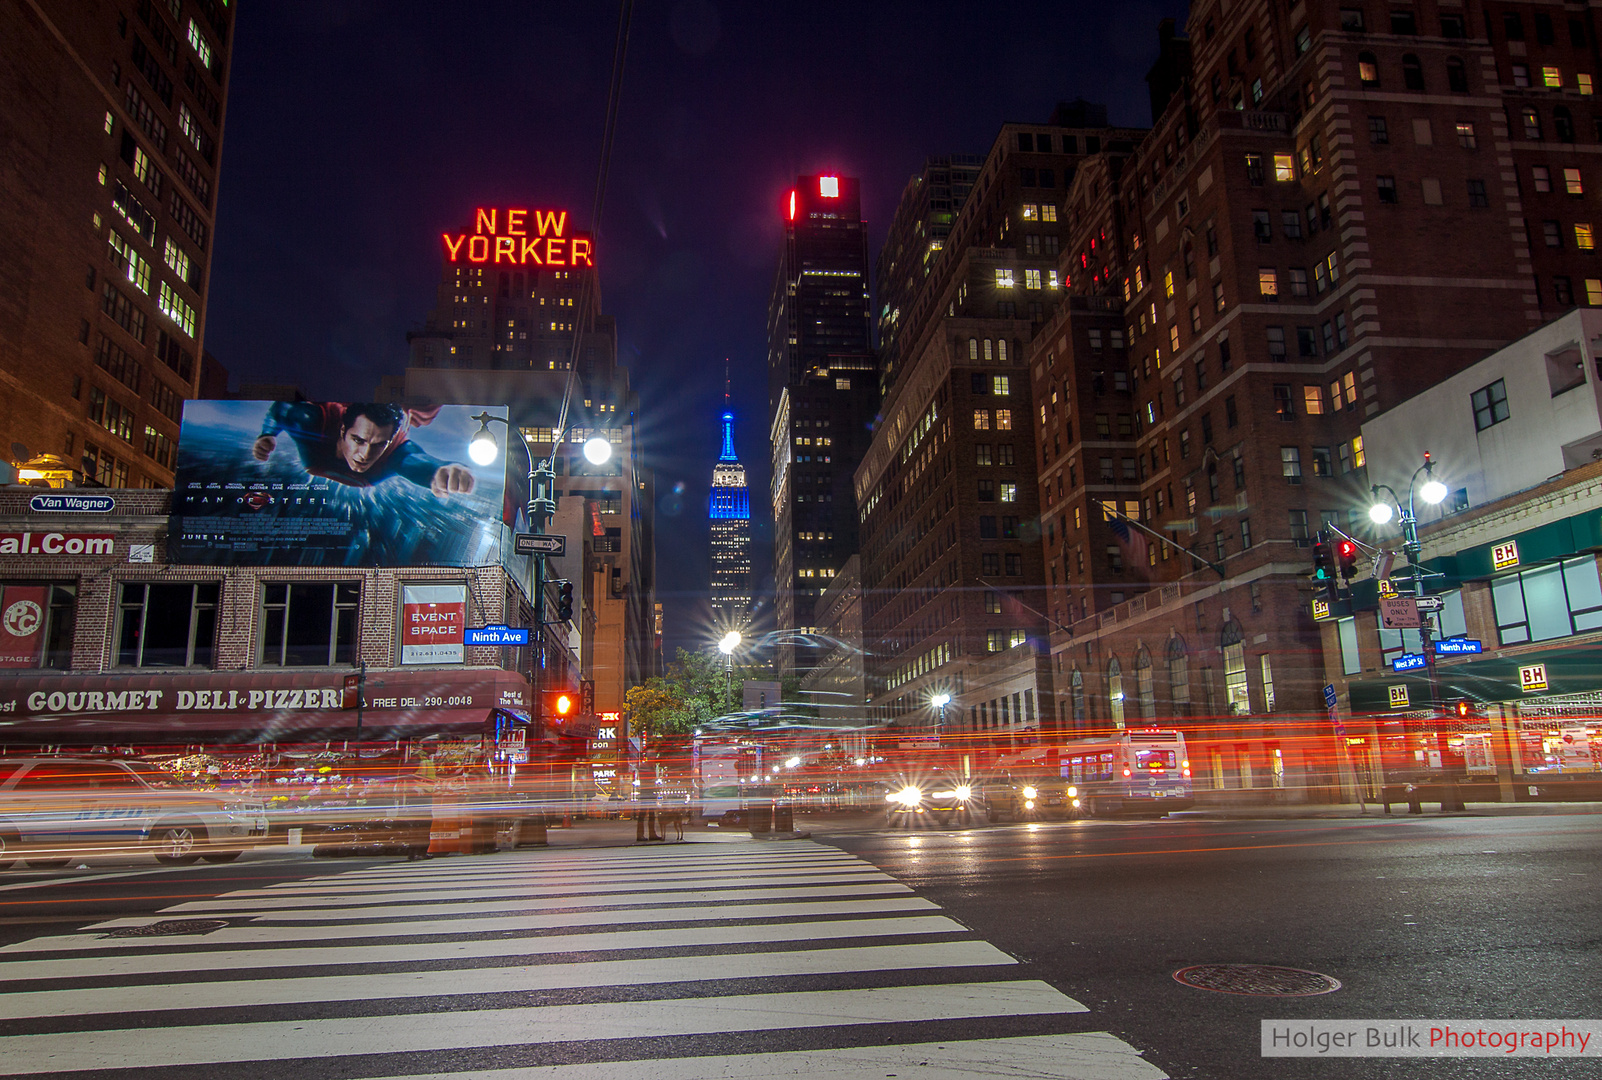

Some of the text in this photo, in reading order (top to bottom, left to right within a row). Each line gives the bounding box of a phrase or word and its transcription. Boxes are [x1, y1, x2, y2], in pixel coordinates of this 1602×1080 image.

[477, 208, 566, 237] NEW
[443, 232, 592, 266] YORKER
[40, 497, 109, 510] Van Wagner
[269, 497, 328, 505] STEEL
[0, 533, 114, 554] al.Com
[412, 612, 457, 622] EVENT
[411, 626, 457, 635] SPACE
[472, 632, 522, 642] Ninth Ave
[1440, 643, 1477, 652] Ninth Ave
[1395, 660, 1408, 669] West
[1417, 657, 1424, 665] St
[27, 689, 163, 711] GOURMET
[176, 690, 238, 710] DELI
[248, 689, 368, 709] PIZZER
[373, 698, 397, 708] FREE
[400, 697, 421, 707] DEL.
[424, 696, 472, 706] 290-0048
[501, 731, 523, 742] ATM
[593, 770, 616, 778] PARK
[75, 804, 143, 820] NYPD
